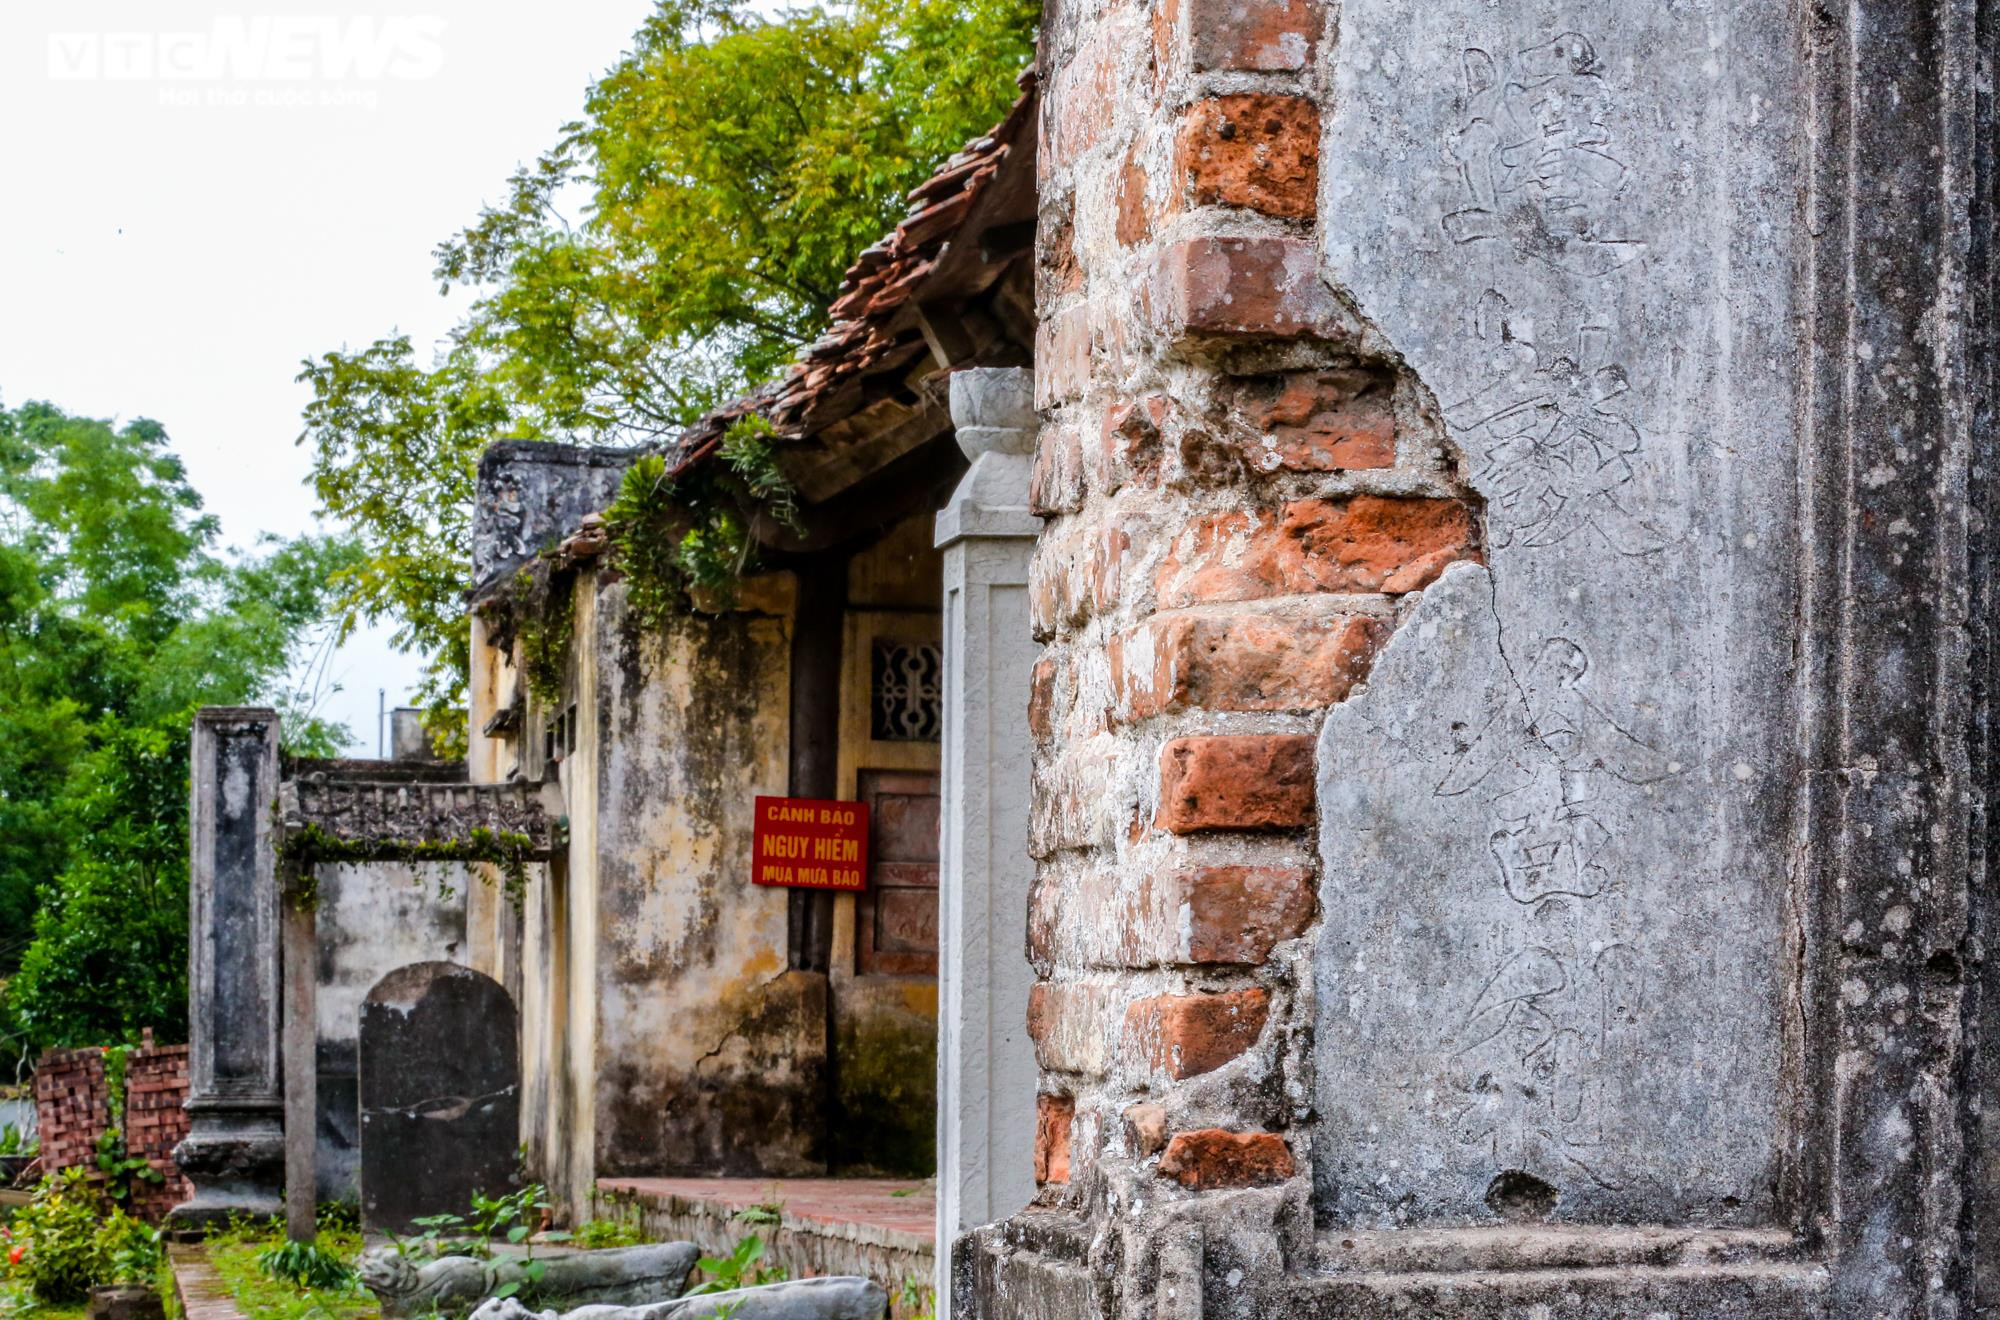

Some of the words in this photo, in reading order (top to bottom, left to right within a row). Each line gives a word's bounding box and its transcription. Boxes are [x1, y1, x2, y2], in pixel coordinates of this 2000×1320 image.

[767, 801, 815, 823] CẢNH
[820, 806, 855, 826] BÁO
[762, 834, 810, 859] NGUY
[815, 828, 859, 862] HIỂM
[798, 867, 829, 885] MƯA
[833, 866, 860, 887] BÃO
